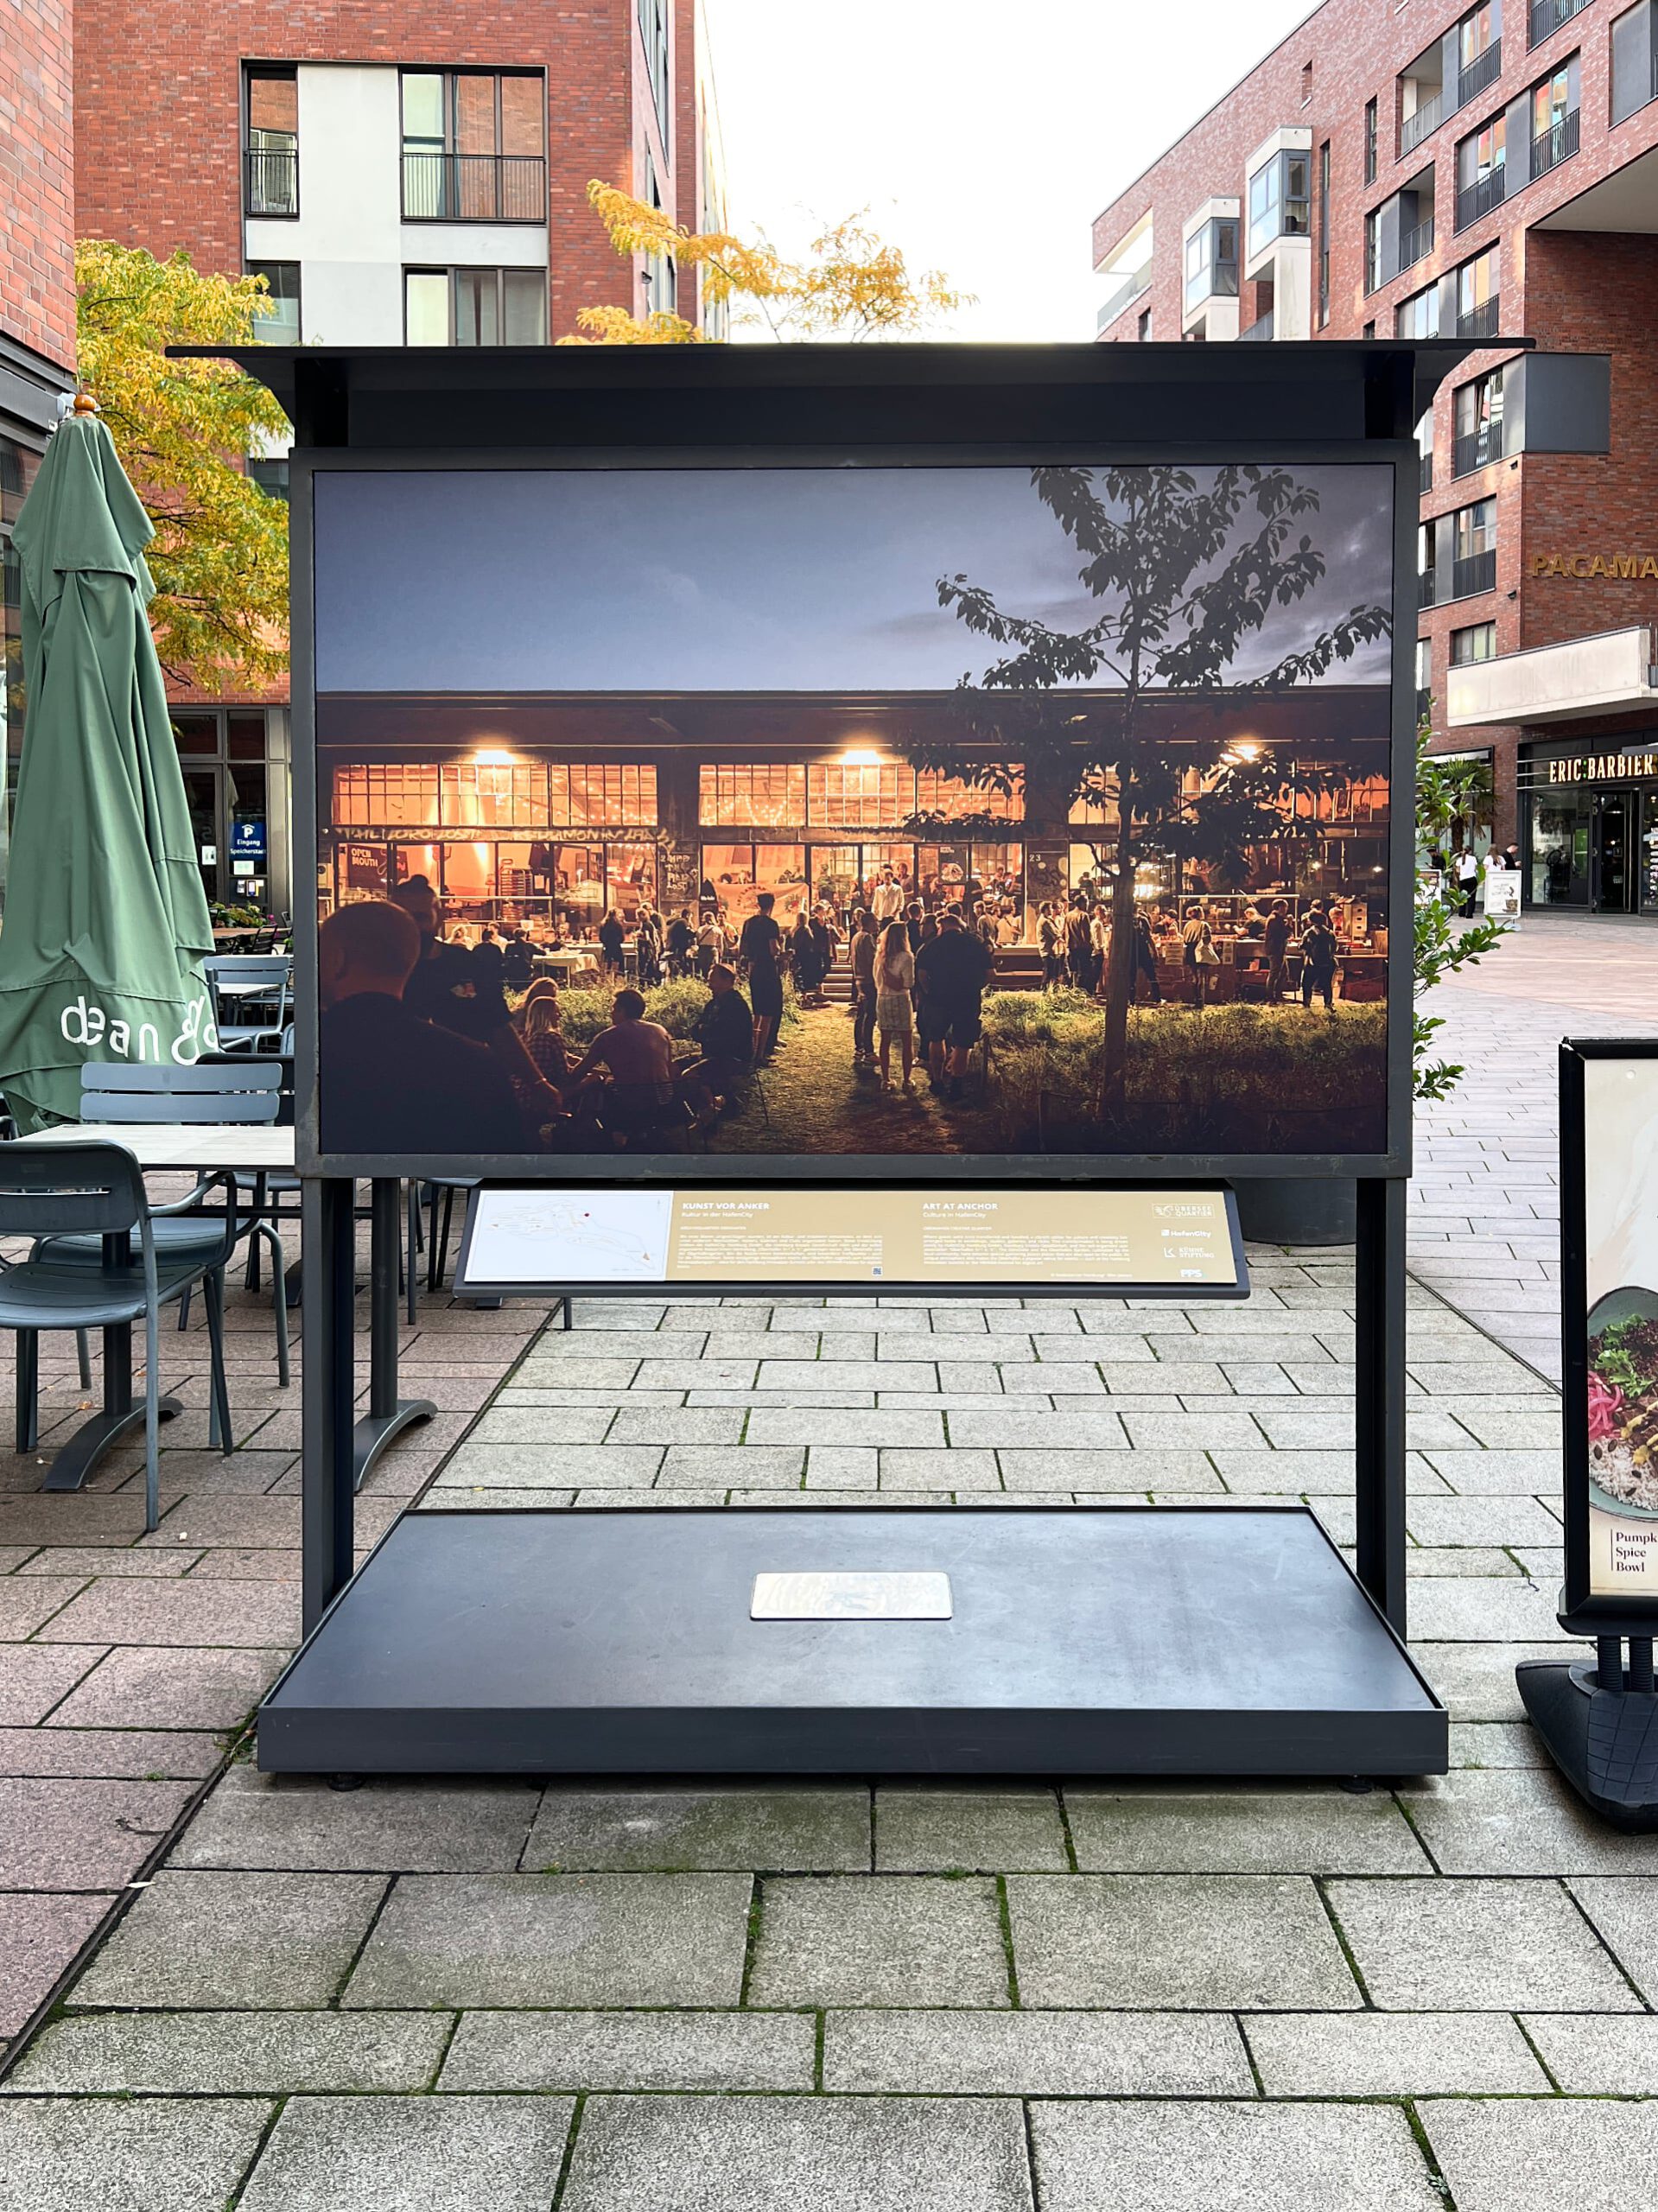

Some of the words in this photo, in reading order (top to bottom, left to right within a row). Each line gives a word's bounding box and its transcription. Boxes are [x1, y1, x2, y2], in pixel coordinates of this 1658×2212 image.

[351, 848, 372, 858] OPEN
[352, 856, 378, 867] MOUTH
[60, 995, 161, 1062] dean
[737, 1202, 770, 1211] ANKER
[1616, 1532, 1657, 1545] Pumpk
[1616, 1547, 1647, 1560] Spice
[1617, 1561, 1645, 1573] Bowl
